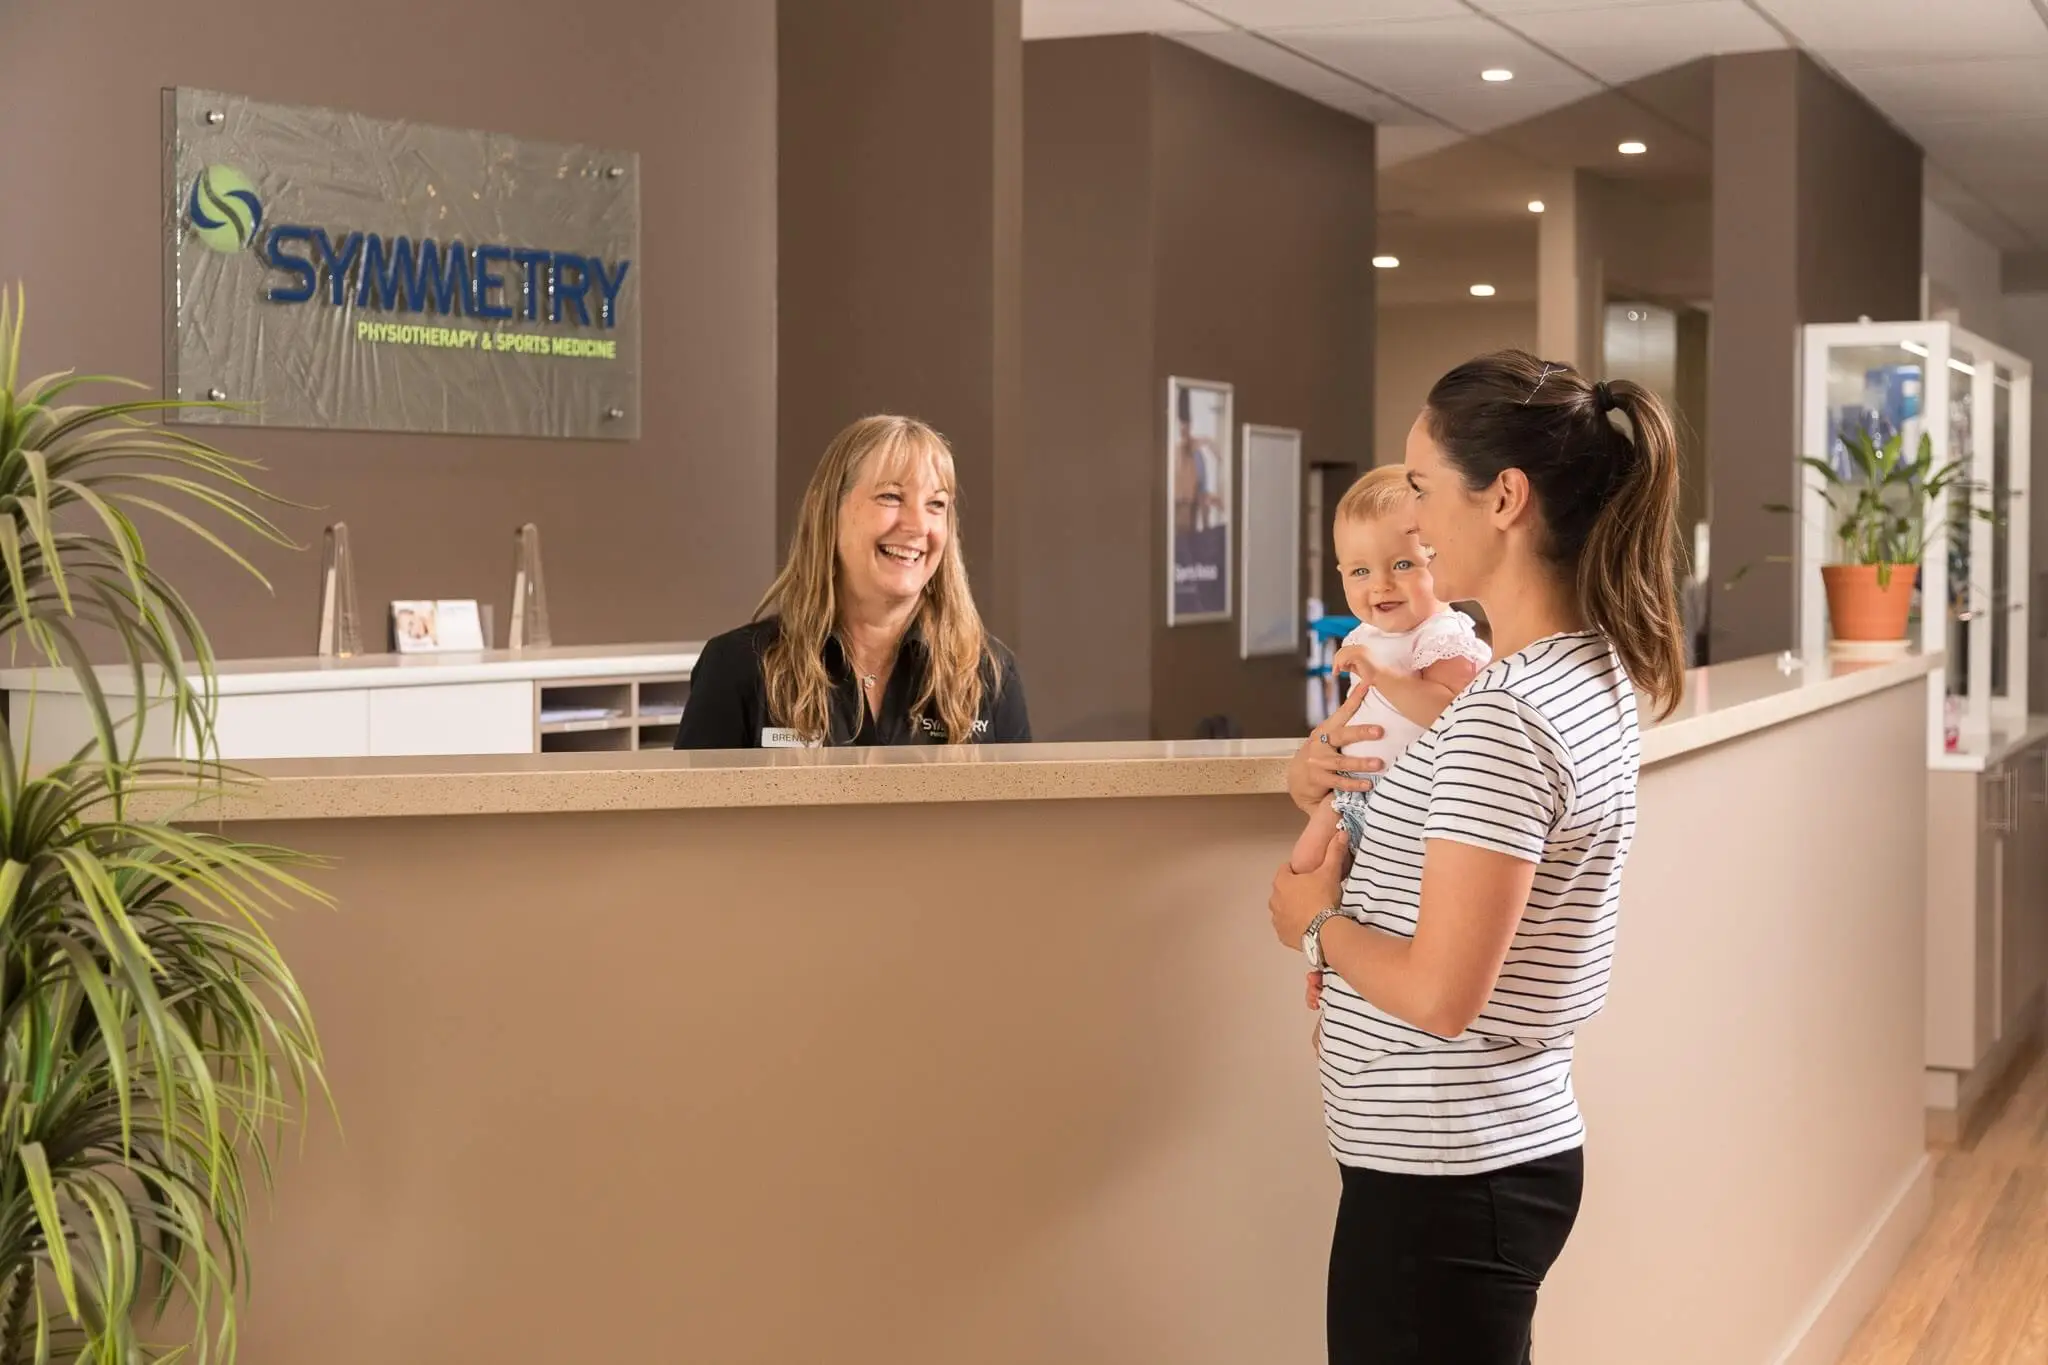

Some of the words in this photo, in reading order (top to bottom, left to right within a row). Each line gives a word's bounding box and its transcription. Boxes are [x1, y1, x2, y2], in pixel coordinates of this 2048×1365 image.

[267, 225, 631, 329] SYMMETRY
[358, 320, 479, 349] PHYSIOTHERAPY
[480, 331, 492, 351] &
[496, 333, 550, 355] SPORTS
[551, 337, 617, 360] MEDICINE
